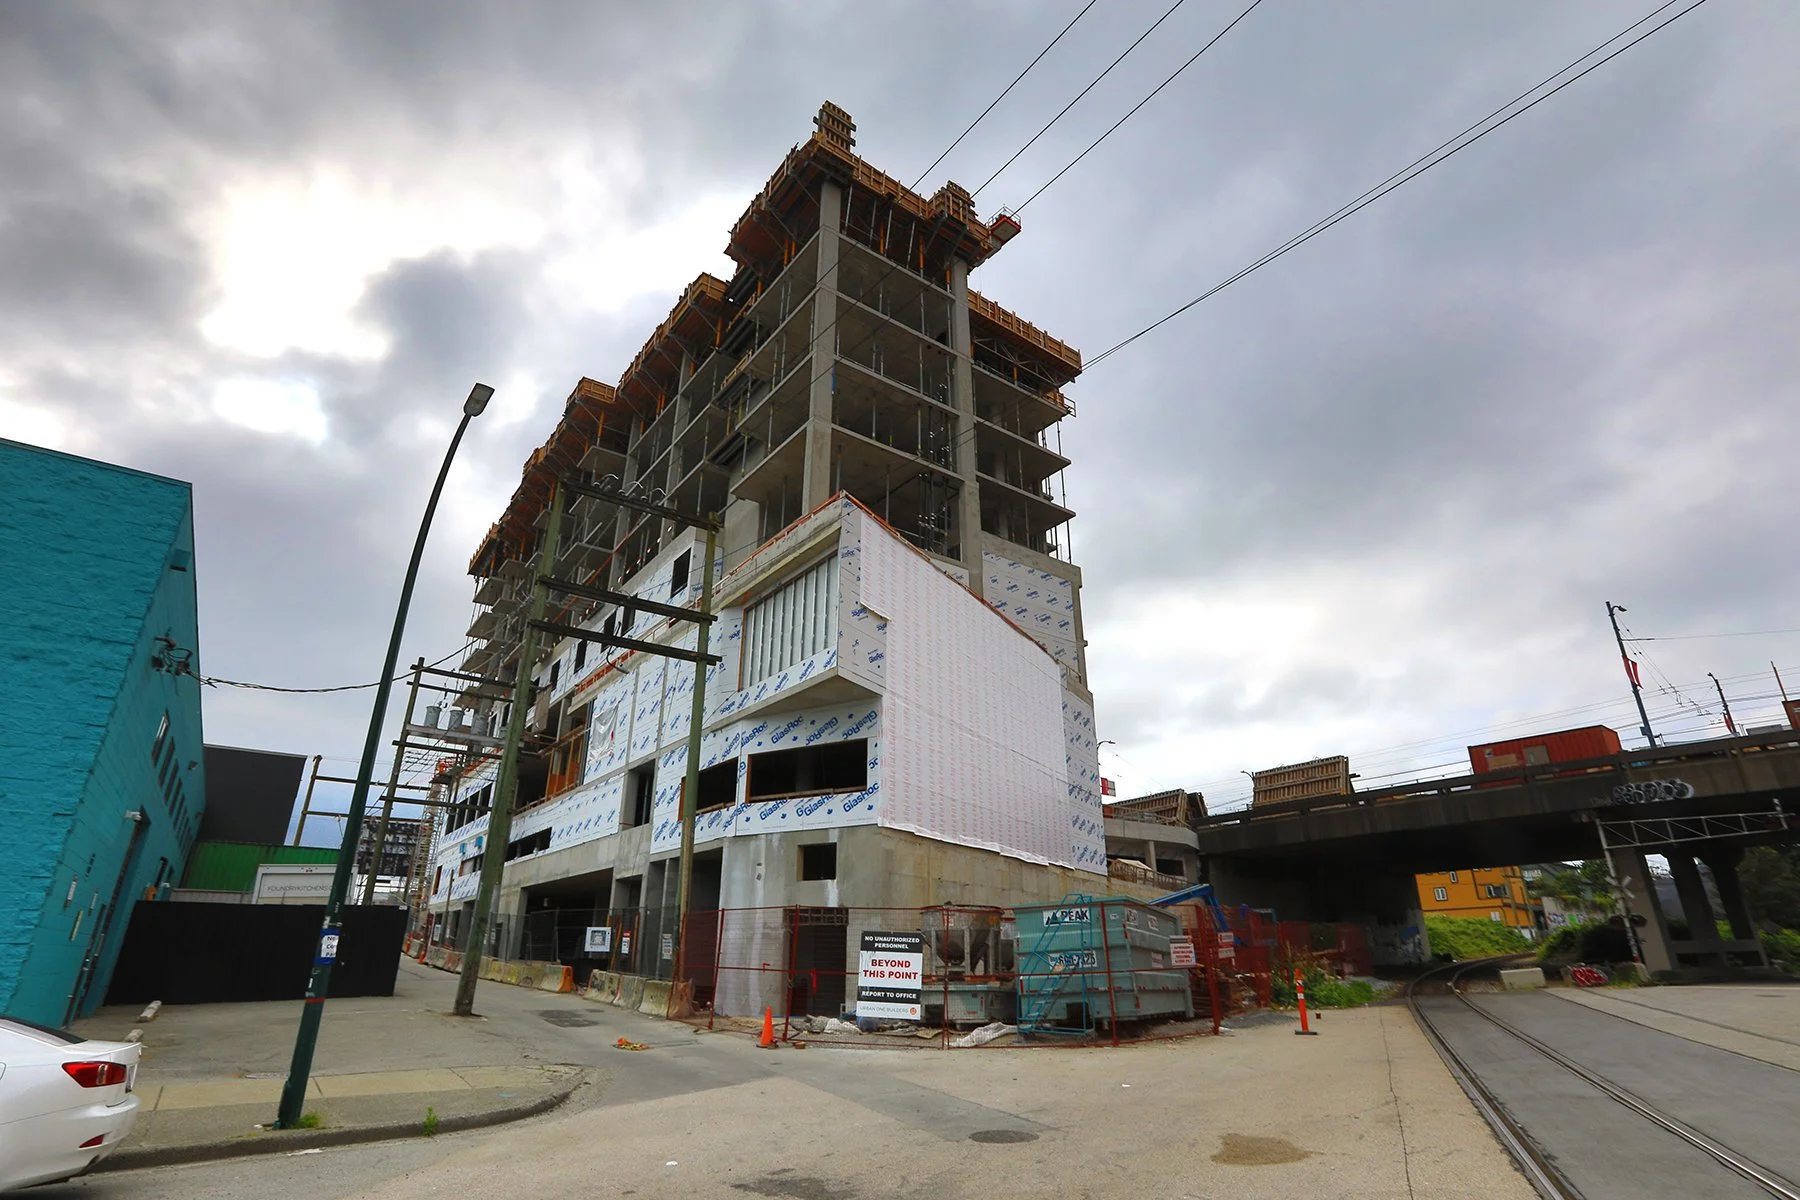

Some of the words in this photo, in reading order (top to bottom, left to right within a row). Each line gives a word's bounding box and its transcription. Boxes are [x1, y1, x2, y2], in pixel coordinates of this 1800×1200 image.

[740, 721, 769, 748] lasRoc
[771, 715, 804, 744] GlasRoc
[842, 710, 878, 740] GlasRoc
[842, 782, 880, 813] GlasRoc
[1061, 910, 1089, 921] PEAK
[863, 970, 886, 978] THIS
[888, 971, 918, 980] POINT
[871, 959, 911, 968] BEYOND
